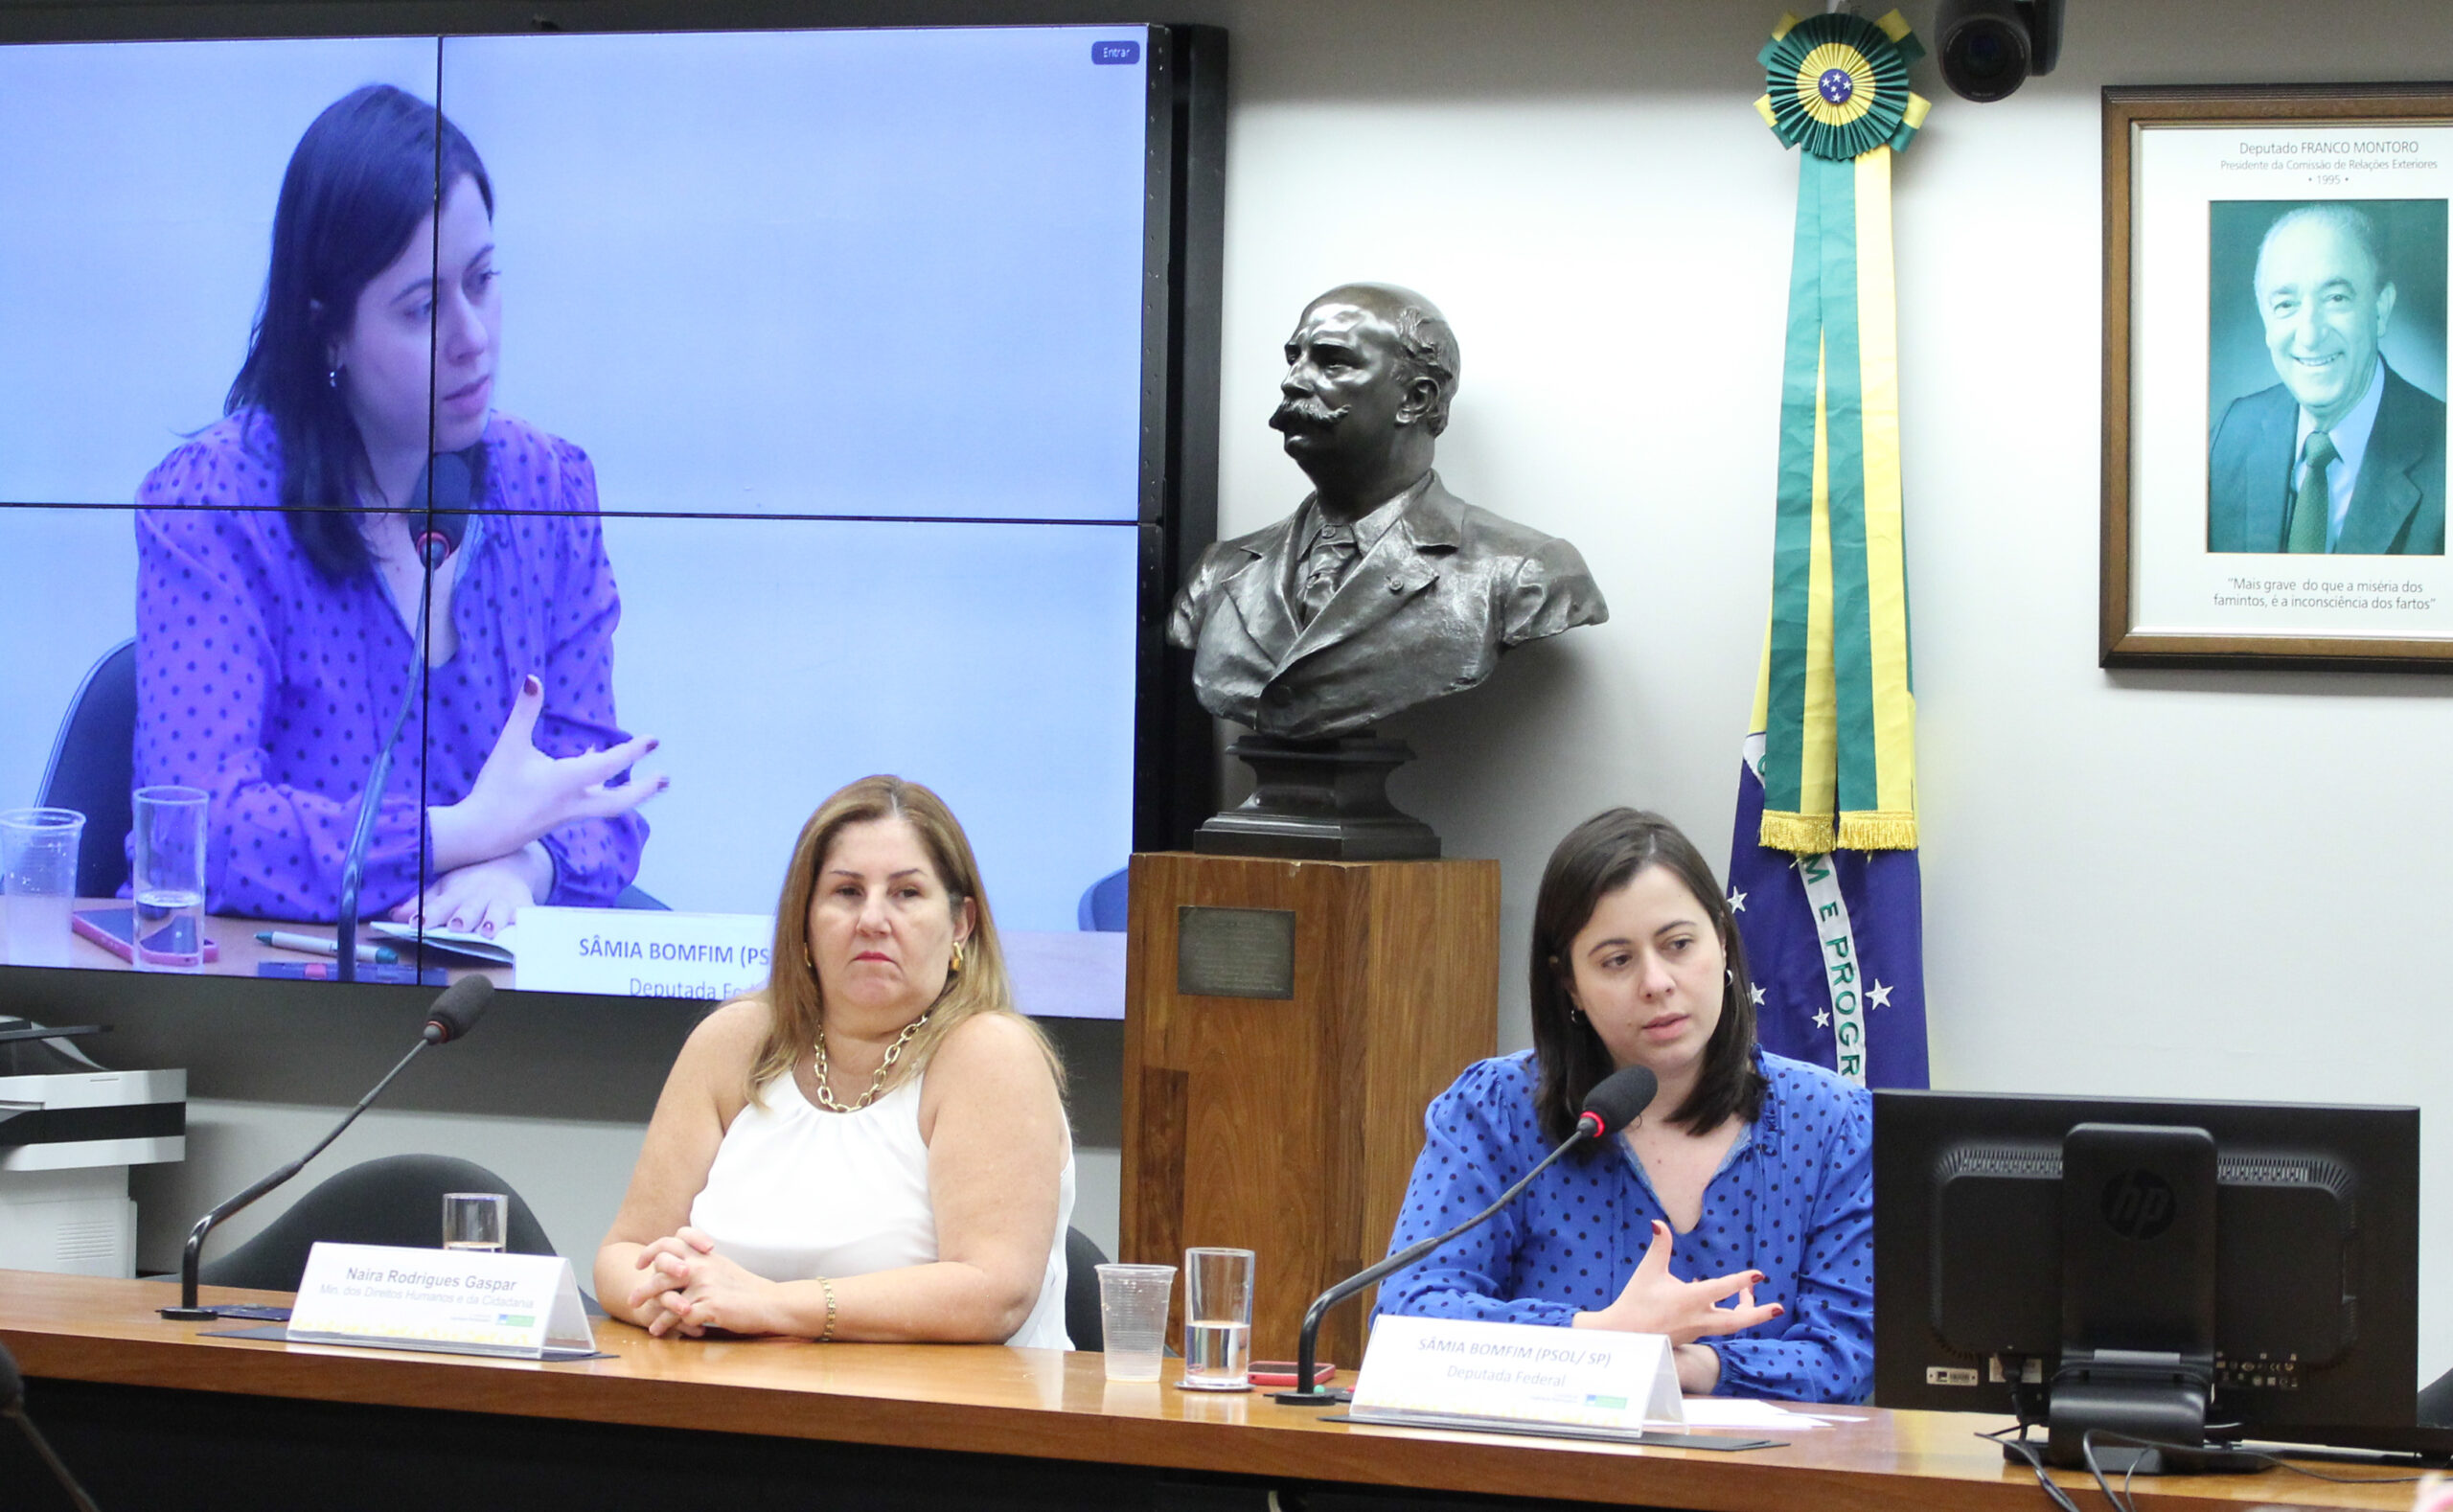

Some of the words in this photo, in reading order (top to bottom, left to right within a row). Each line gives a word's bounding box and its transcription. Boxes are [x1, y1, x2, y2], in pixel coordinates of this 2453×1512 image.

[1103, 47, 1131, 58] Entrar
[2239, 141, 2298, 156] Deputado
[2301, 141, 2350, 154] FRANCO
[2352, 140, 2419, 154] MONTORO
[2220, 160, 2269, 171] Presidente
[2271, 160, 2284, 170] da
[2286, 159, 2331, 170] Comissão
[2334, 159, 2347, 170] de
[2349, 158, 2390, 172] Relações
[2392, 158, 2438, 170] Exteriores
[2316, 174, 2341, 185] 1995
[2263, 580, 2297, 594] grave
[2302, 579, 2319, 591] do
[2321, 581, 2345, 594] que
[2347, 582, 2354, 592] a
[2356, 580, 2398, 592] miséria
[2401, 580, 2423, 593] dos
[2213, 593, 2268, 608] famintos,
[2271, 594, 2280, 607] é
[2281, 597, 2288, 607] a
[2290, 595, 2369, 608] inconsciência
[2371, 595, 2394, 609] dos
[1820, 900, 1839, 923] E
[579, 934, 643, 959] SÂMIA
[650, 942, 733, 964] BOMFIM
[630, 977, 717, 1000] Deputada
[2107, 1170, 2170, 1240] hp
[346, 1266, 383, 1283] Naira
[387, 1269, 460, 1290] Rodrigues
[464, 1274, 518, 1292] Gaspar
[343, 1285, 361, 1296] dos
[364, 1287, 403, 1300] Direitos
[405, 1290, 455, 1304] Humanos
[456, 1294, 464, 1304] e
[466, 1294, 480, 1305] da
[482, 1294, 535, 1309] Cidadania
[1417, 1336, 1466, 1353] SÂMIA
[1469, 1342, 1534, 1360] BOMFIM
[1535, 1346, 1586, 1365] (PSOL/
[1587, 1351, 1612, 1369] SP)
[1446, 1364, 1512, 1383] Deputada
[1515, 1370, 1567, 1388] Federal
